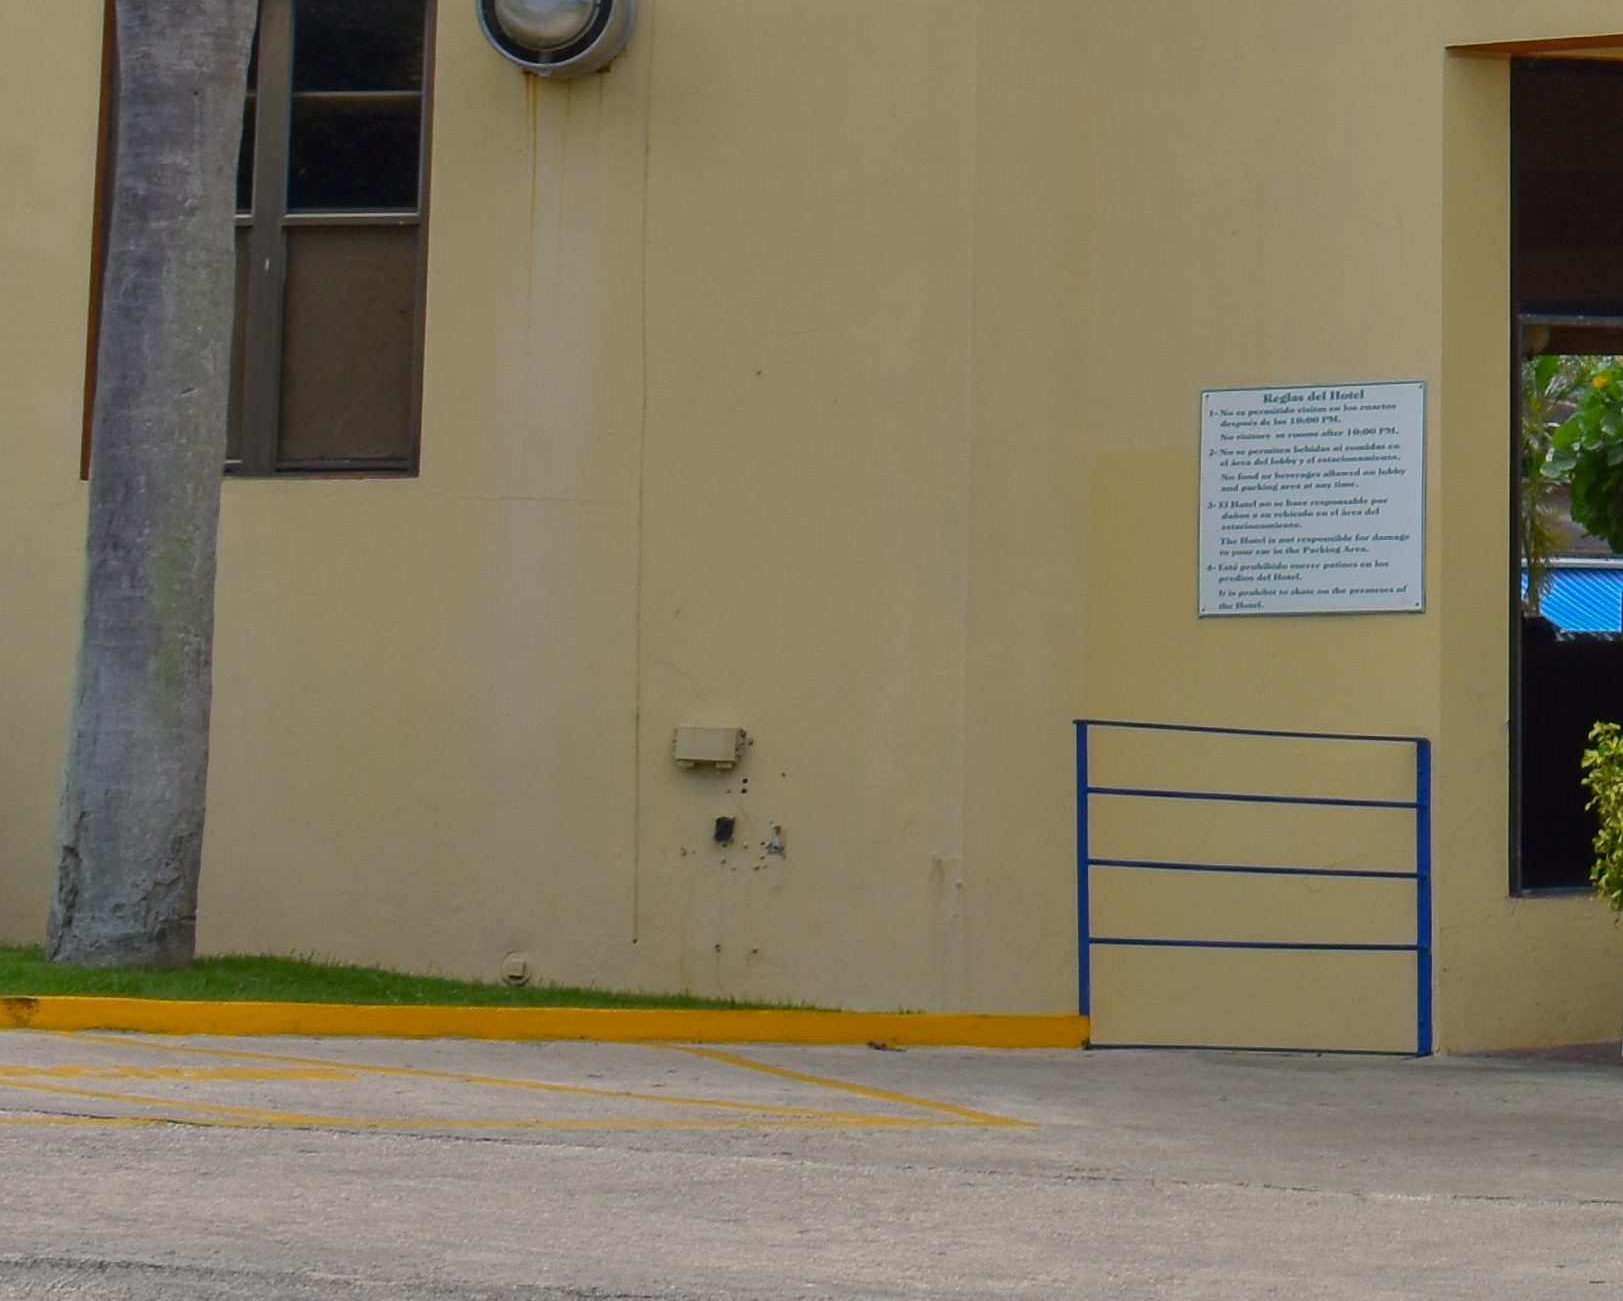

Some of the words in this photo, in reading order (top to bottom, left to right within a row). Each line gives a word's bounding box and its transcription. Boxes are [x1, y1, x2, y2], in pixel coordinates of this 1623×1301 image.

[1263, 392, 1304, 404] Reglas
[1307, 391, 1326, 401] del
[1330, 389, 1364, 400] Hotel
[1248, 406, 1295, 416] permitido
[1290, 416, 1319, 424] 10:00
[1347, 427, 1376, 435] 10:00
[1270, 457, 1296, 465] lobby
[1238, 471, 1258, 479] food
[1275, 471, 1320, 479] beverages
[1323, 468, 1360, 477] allowed
[1378, 467, 1405, 476] lobby
[1241, 482, 1278, 492] parking
[1231, 499, 1256, 508] Hotel
[1330, 508, 1339, 516] el
[1221, 537, 1237, 545] The
[1240, 536, 1266, 544] Hotel
[1285, 546, 1299, 554] the
[1303, 546, 1340, 554] Parking
